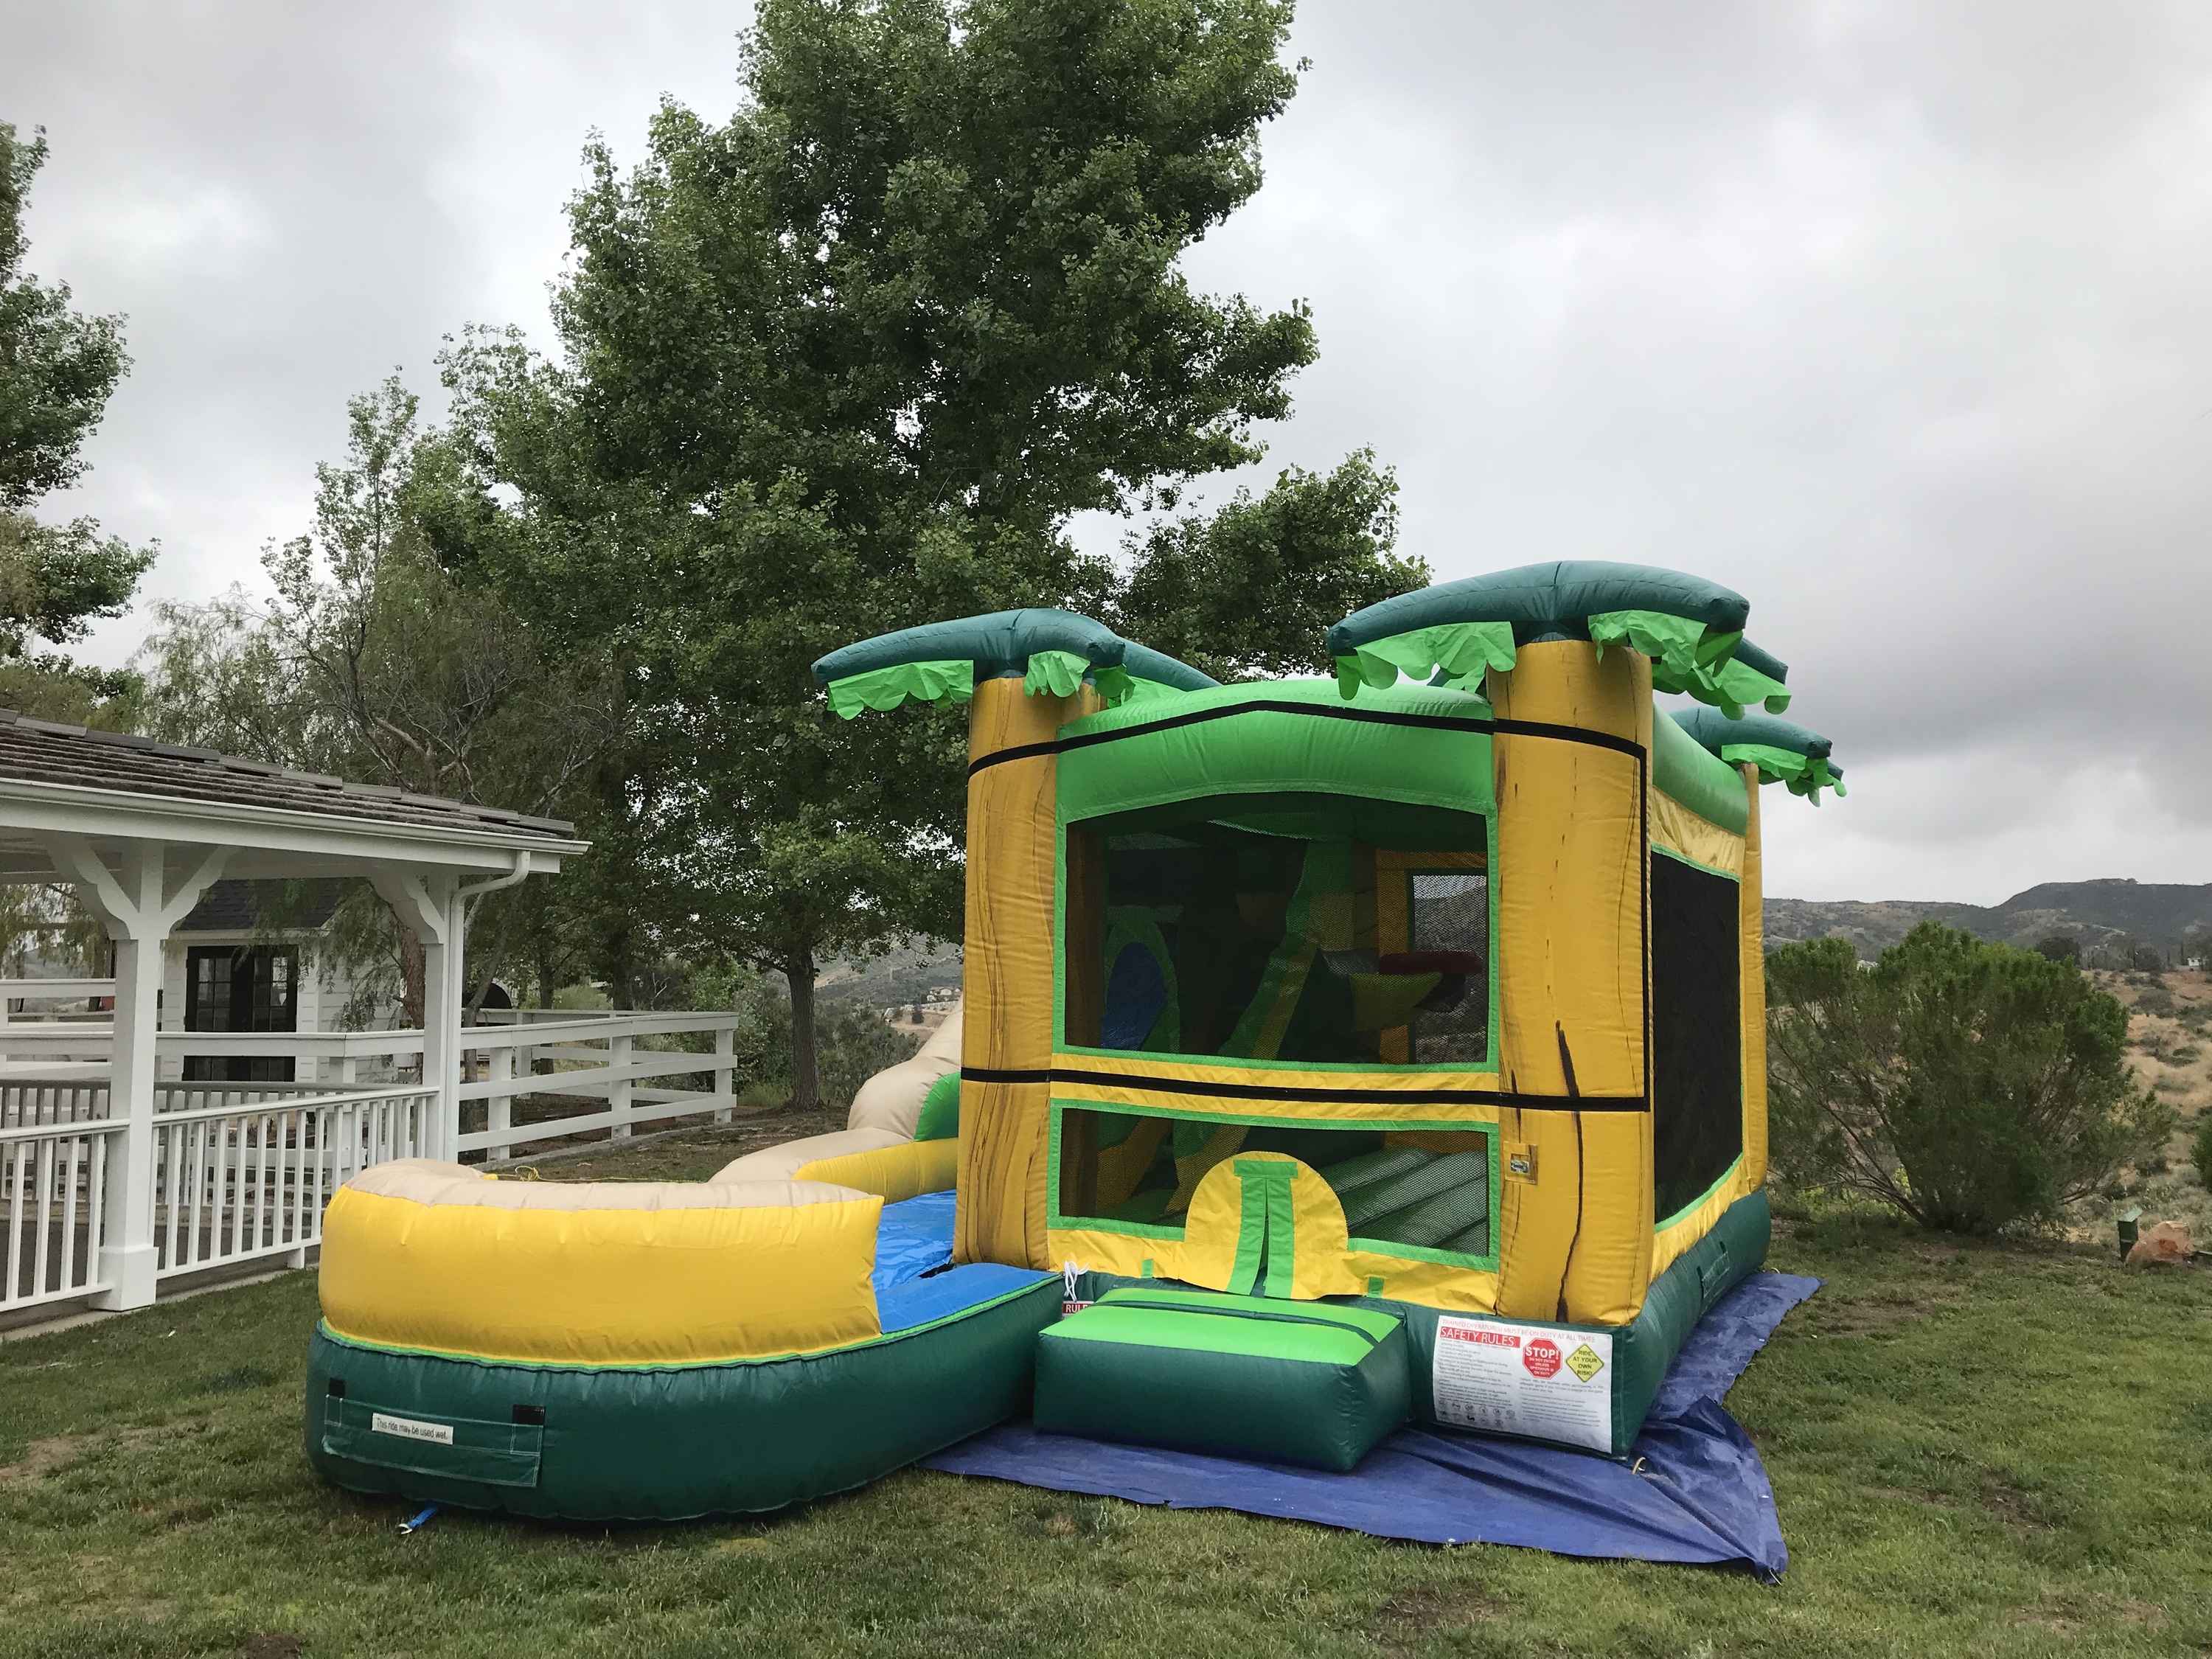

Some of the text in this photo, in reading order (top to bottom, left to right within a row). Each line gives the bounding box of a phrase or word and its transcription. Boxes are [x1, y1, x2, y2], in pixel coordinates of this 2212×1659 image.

[1442, 1319, 1466, 1327] TRAINED
[1467, 1323, 1503, 1332] OPERATOR(S)
[1441, 1327, 1514, 1346] SAFETY RULES
[1526, 1346, 1559, 1360] STOP!
[376, 1417, 387, 1429] This
[388, 1422, 397, 1431] ride
[399, 1425, 411, 1436] may
[411, 1425, 419, 1435] be
[420, 1428, 434, 1438] used
